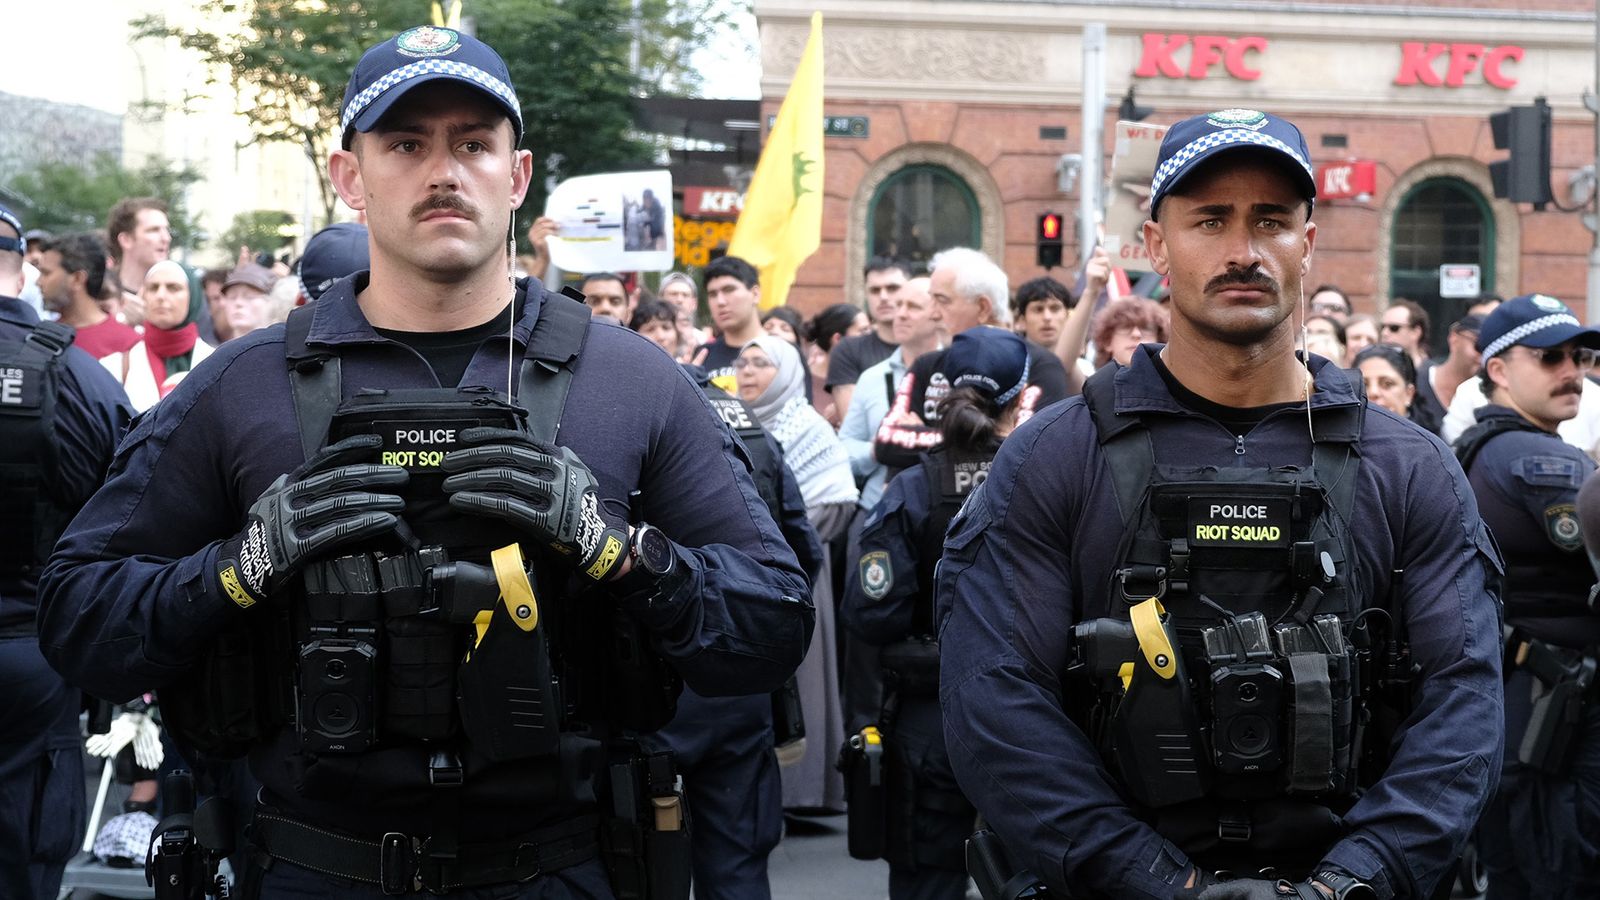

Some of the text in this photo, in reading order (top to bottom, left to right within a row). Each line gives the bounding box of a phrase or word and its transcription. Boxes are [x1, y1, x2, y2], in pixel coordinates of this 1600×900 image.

[1135, 32, 1268, 80] KFC
[1394, 42, 1525, 89] KFC
[0, 368, 24, 379] LES
[395, 429, 456, 444] POLICE
[382, 451, 416, 466] RIOT
[954, 462, 977, 471] NEW
[1210, 504, 1267, 519] POLICE
[1196, 525, 1280, 541] RIOT SQUAD
